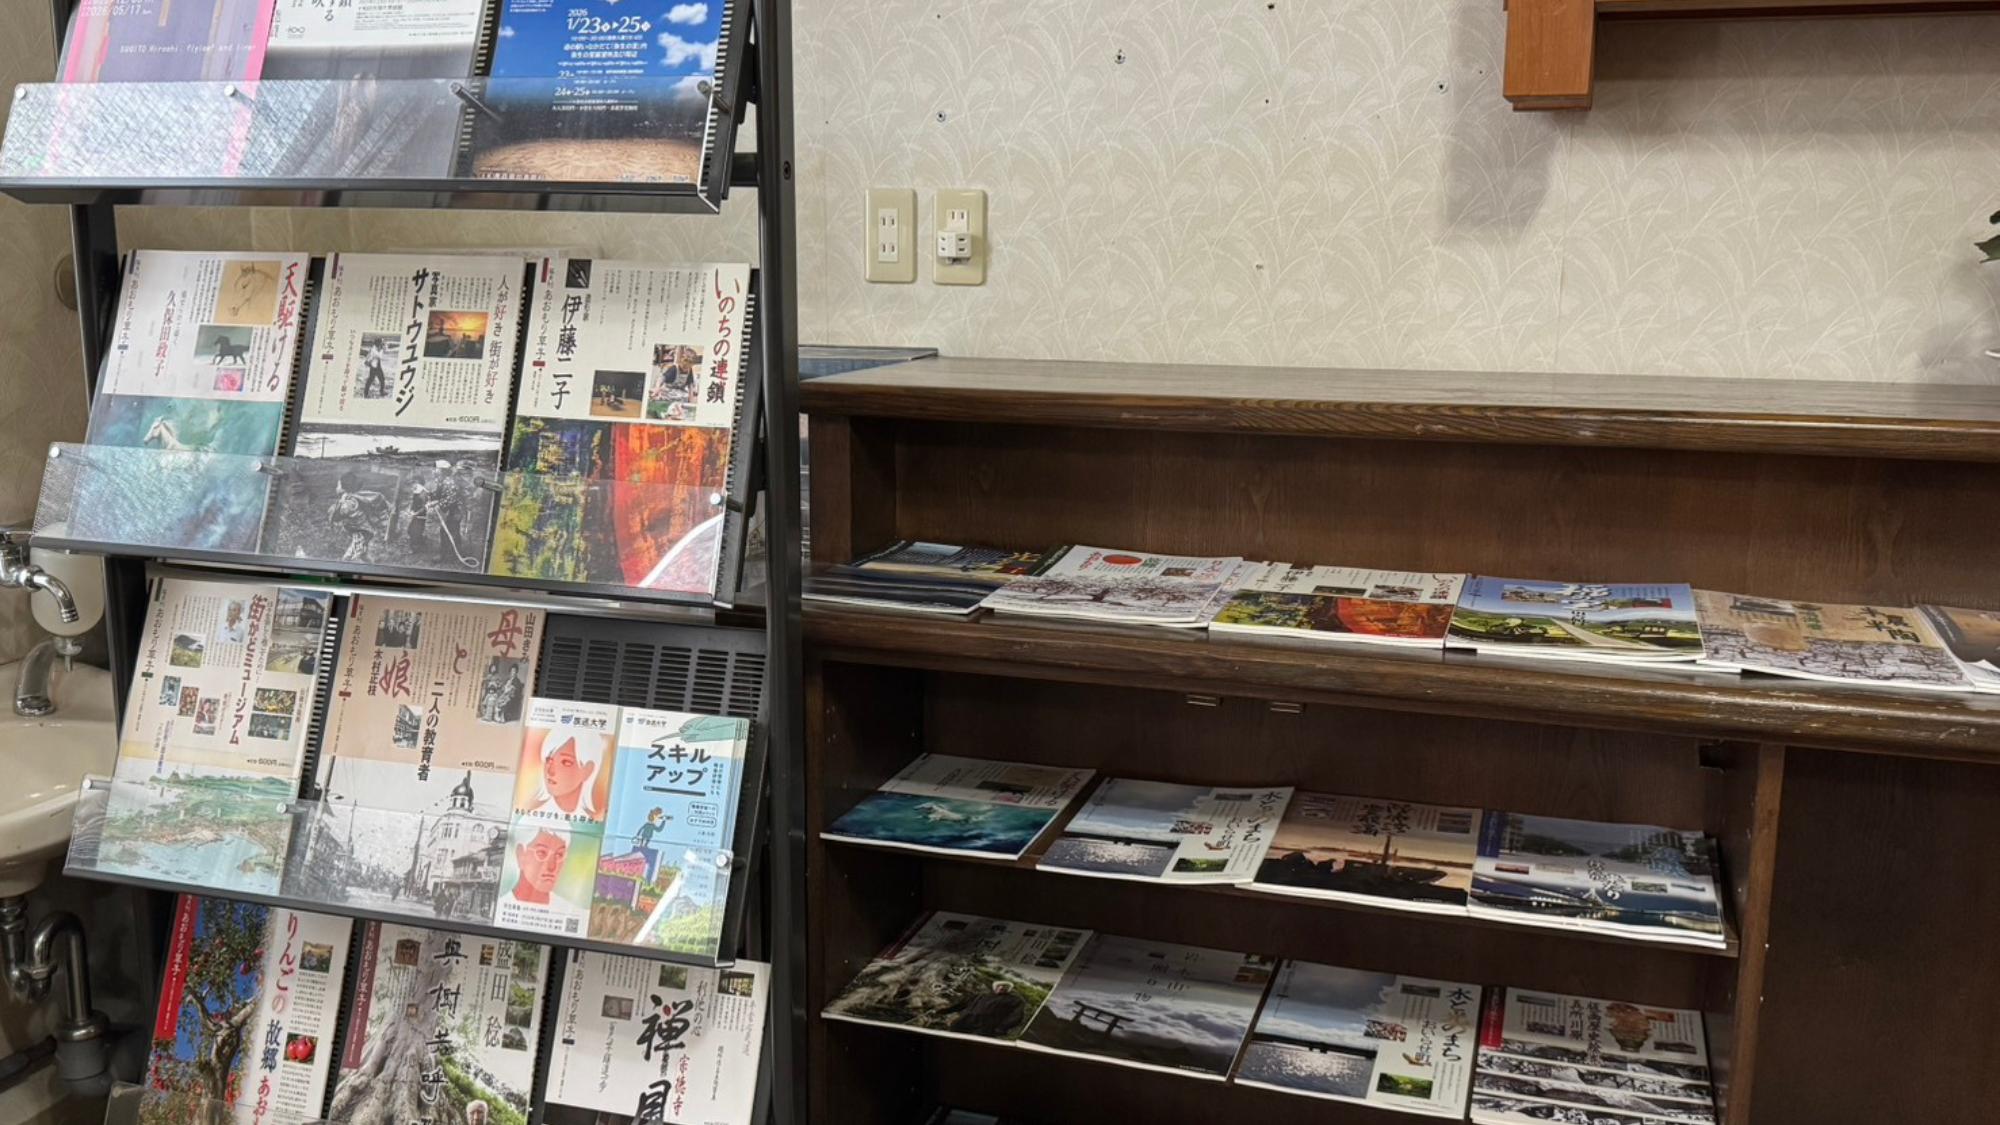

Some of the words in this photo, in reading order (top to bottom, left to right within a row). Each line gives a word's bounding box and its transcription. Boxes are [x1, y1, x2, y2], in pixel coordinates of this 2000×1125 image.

[324, 286, 342, 354] あおもり草子
[427, 271, 441, 308] 写真家
[491, 275, 512, 337] 人が好き
[394, 267, 430, 418] サトウユウジ
[535, 289, 553, 361] あおもり草子
[550, 294, 583, 411] 伊藤二子
[706, 268, 741, 404] いのちの連鎖
[483, 339, 504, 405] 街が好き
[343, 625, 361, 691] あおもり草子
[453, 642, 468, 674] と
[487, 609, 524, 657] 母
[228, 593, 269, 747] 街かどミュージアム
[379, 650, 411, 699] 娘
[416, 682, 446, 782] 二人の教育者
[647, 742, 712, 765] スキル
[646, 764, 708, 786] アップ
[260, 912, 299, 1072] りんごの故郷
[563, 969, 585, 1039] あおもり草子
